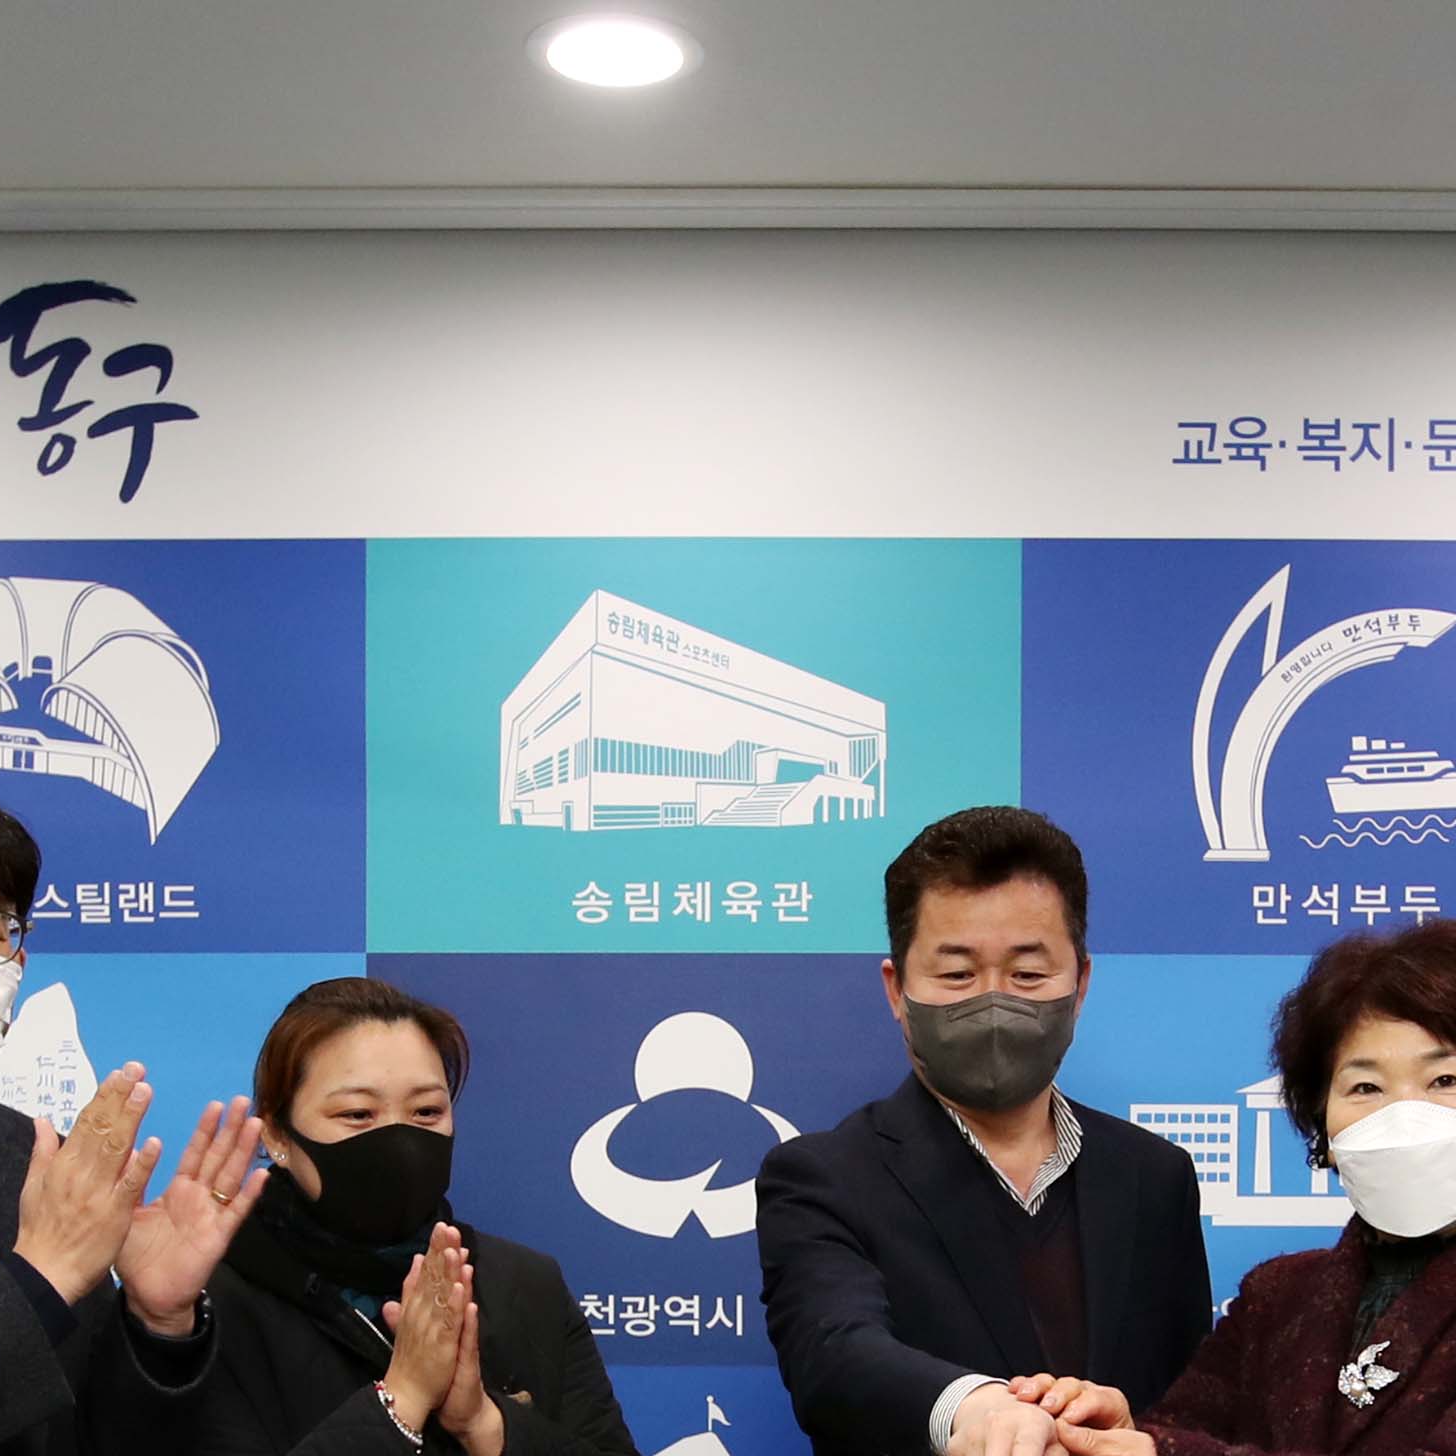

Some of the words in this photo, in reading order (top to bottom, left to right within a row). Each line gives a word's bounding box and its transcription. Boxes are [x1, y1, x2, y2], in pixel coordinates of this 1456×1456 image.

[607, 611, 681, 654] 송림체육관
[1342, 613, 1422, 644] 만석부두
[31, 881, 200, 924] 스틸랜드
[571, 880, 814, 924] 송림체육관
[1252, 883, 1441, 927] 만석부두
